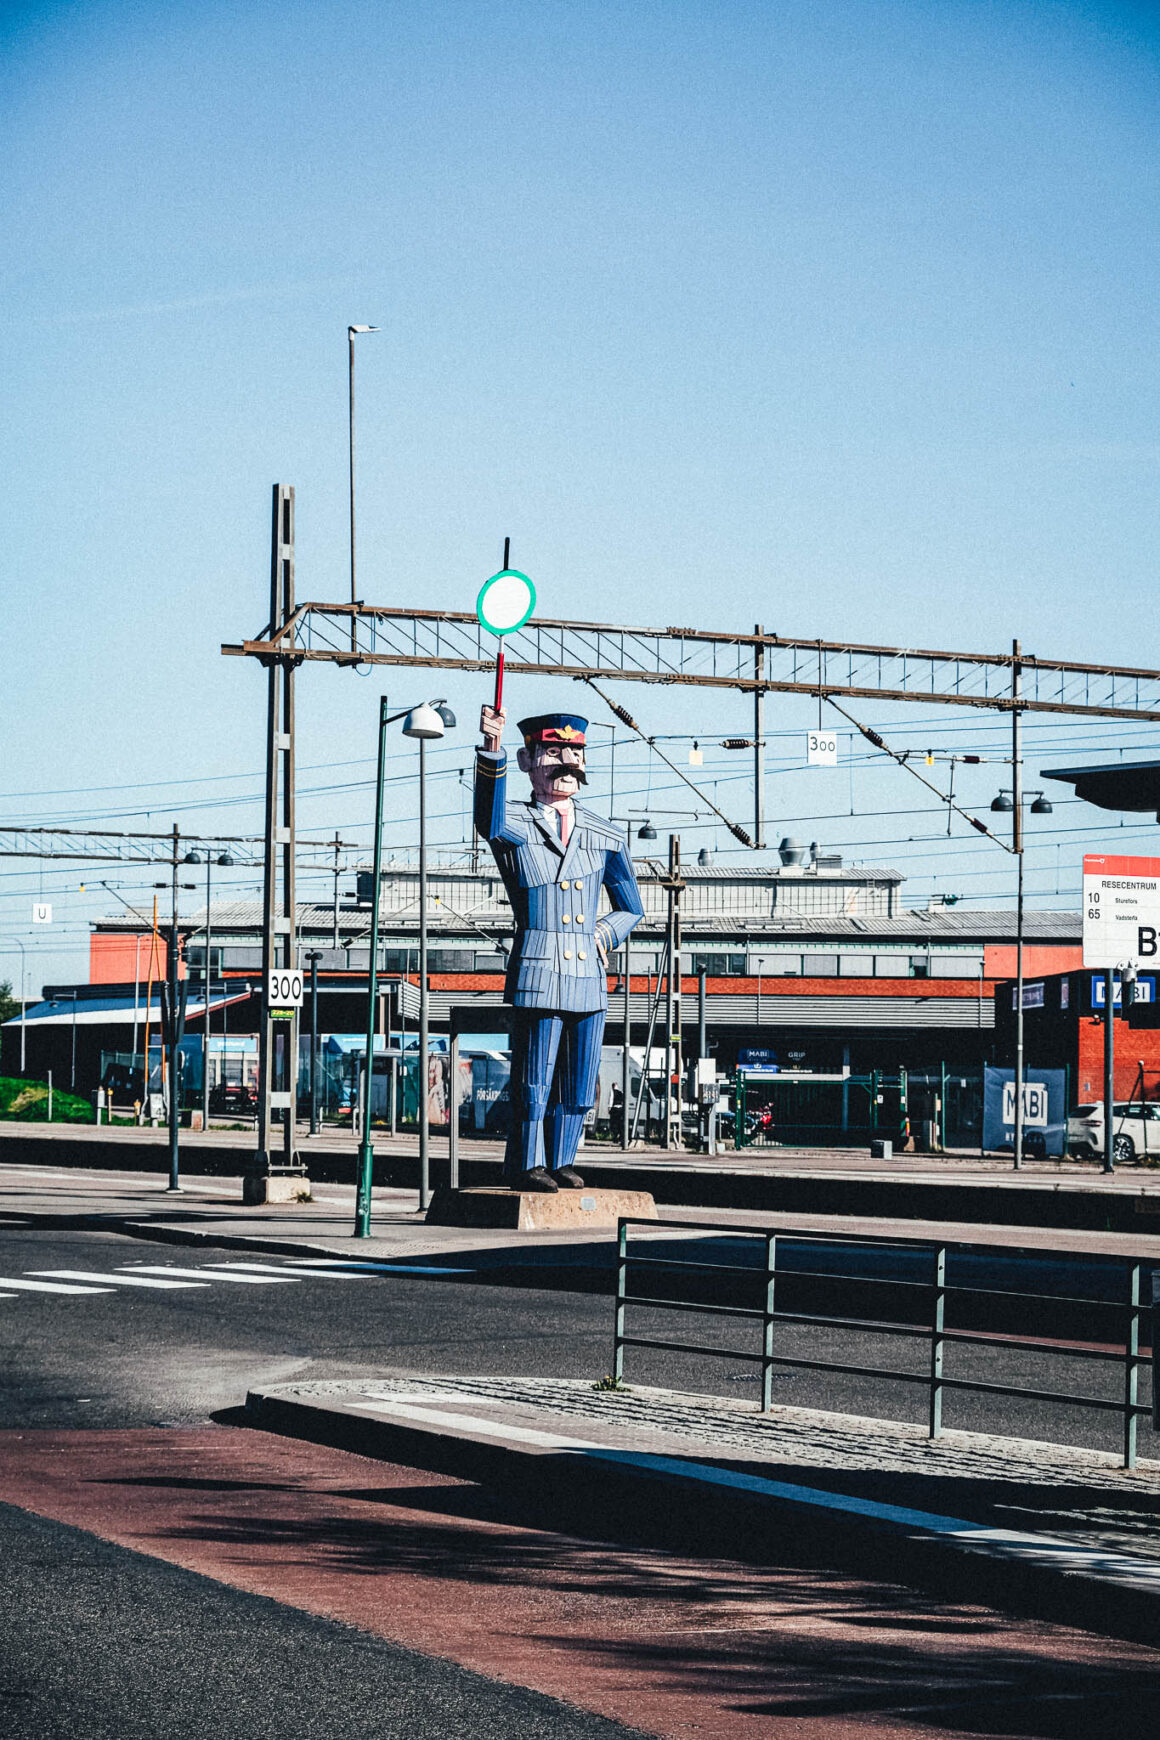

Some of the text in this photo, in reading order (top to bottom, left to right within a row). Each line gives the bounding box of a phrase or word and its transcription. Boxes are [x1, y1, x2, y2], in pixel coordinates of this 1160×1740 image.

[810, 736, 835, 752] 300
[1101, 880, 1157, 890] RESECENTRUM
[1088, 892, 1100, 903] 10
[38, 907, 46, 920] U
[1088, 908, 1101, 920] 65
[270, 976, 302, 1000] 300
